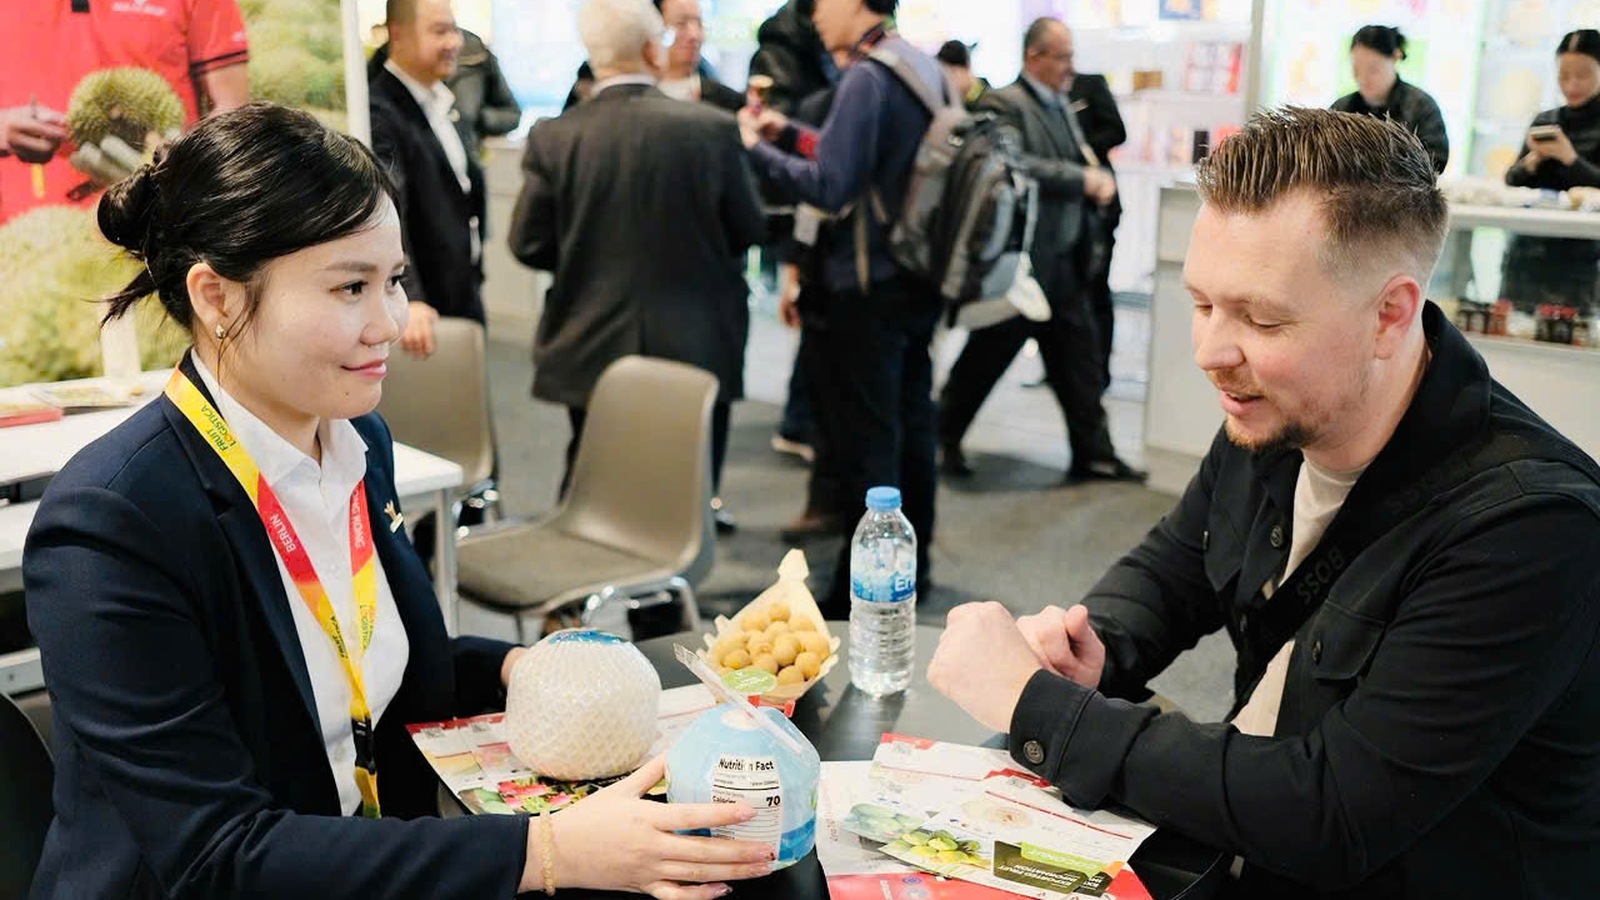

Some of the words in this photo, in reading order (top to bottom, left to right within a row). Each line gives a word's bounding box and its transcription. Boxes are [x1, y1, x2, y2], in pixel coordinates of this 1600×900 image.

[201, 404, 237, 447] LOGISTICA
[206, 428, 229, 452] FRUIT
[270, 513, 296, 552] BERLIN
[1297, 546, 1344, 604] BOSS
[719, 758, 753, 771] Nutritin
[755, 761, 774, 771] Fact
[766, 795, 781, 807] 70
